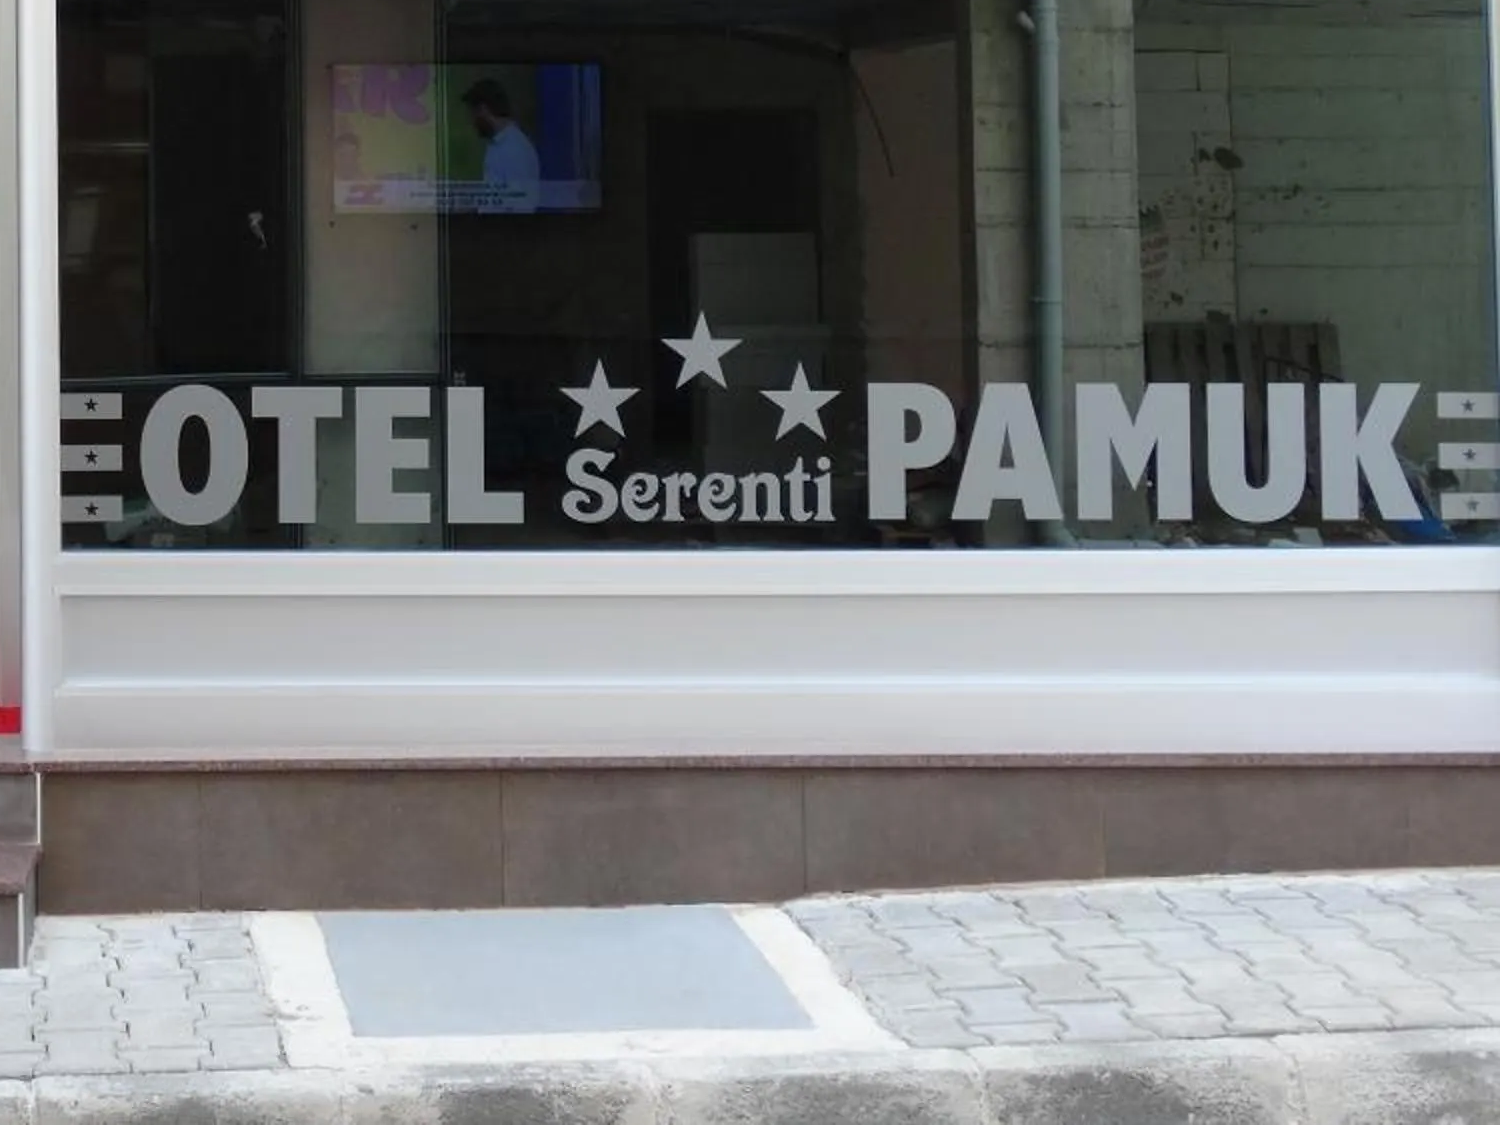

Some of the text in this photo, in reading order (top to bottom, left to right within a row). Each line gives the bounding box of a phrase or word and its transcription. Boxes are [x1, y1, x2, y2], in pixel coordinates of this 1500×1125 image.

[139, 381, 1424, 526] OTEL Serenti PAMUK
